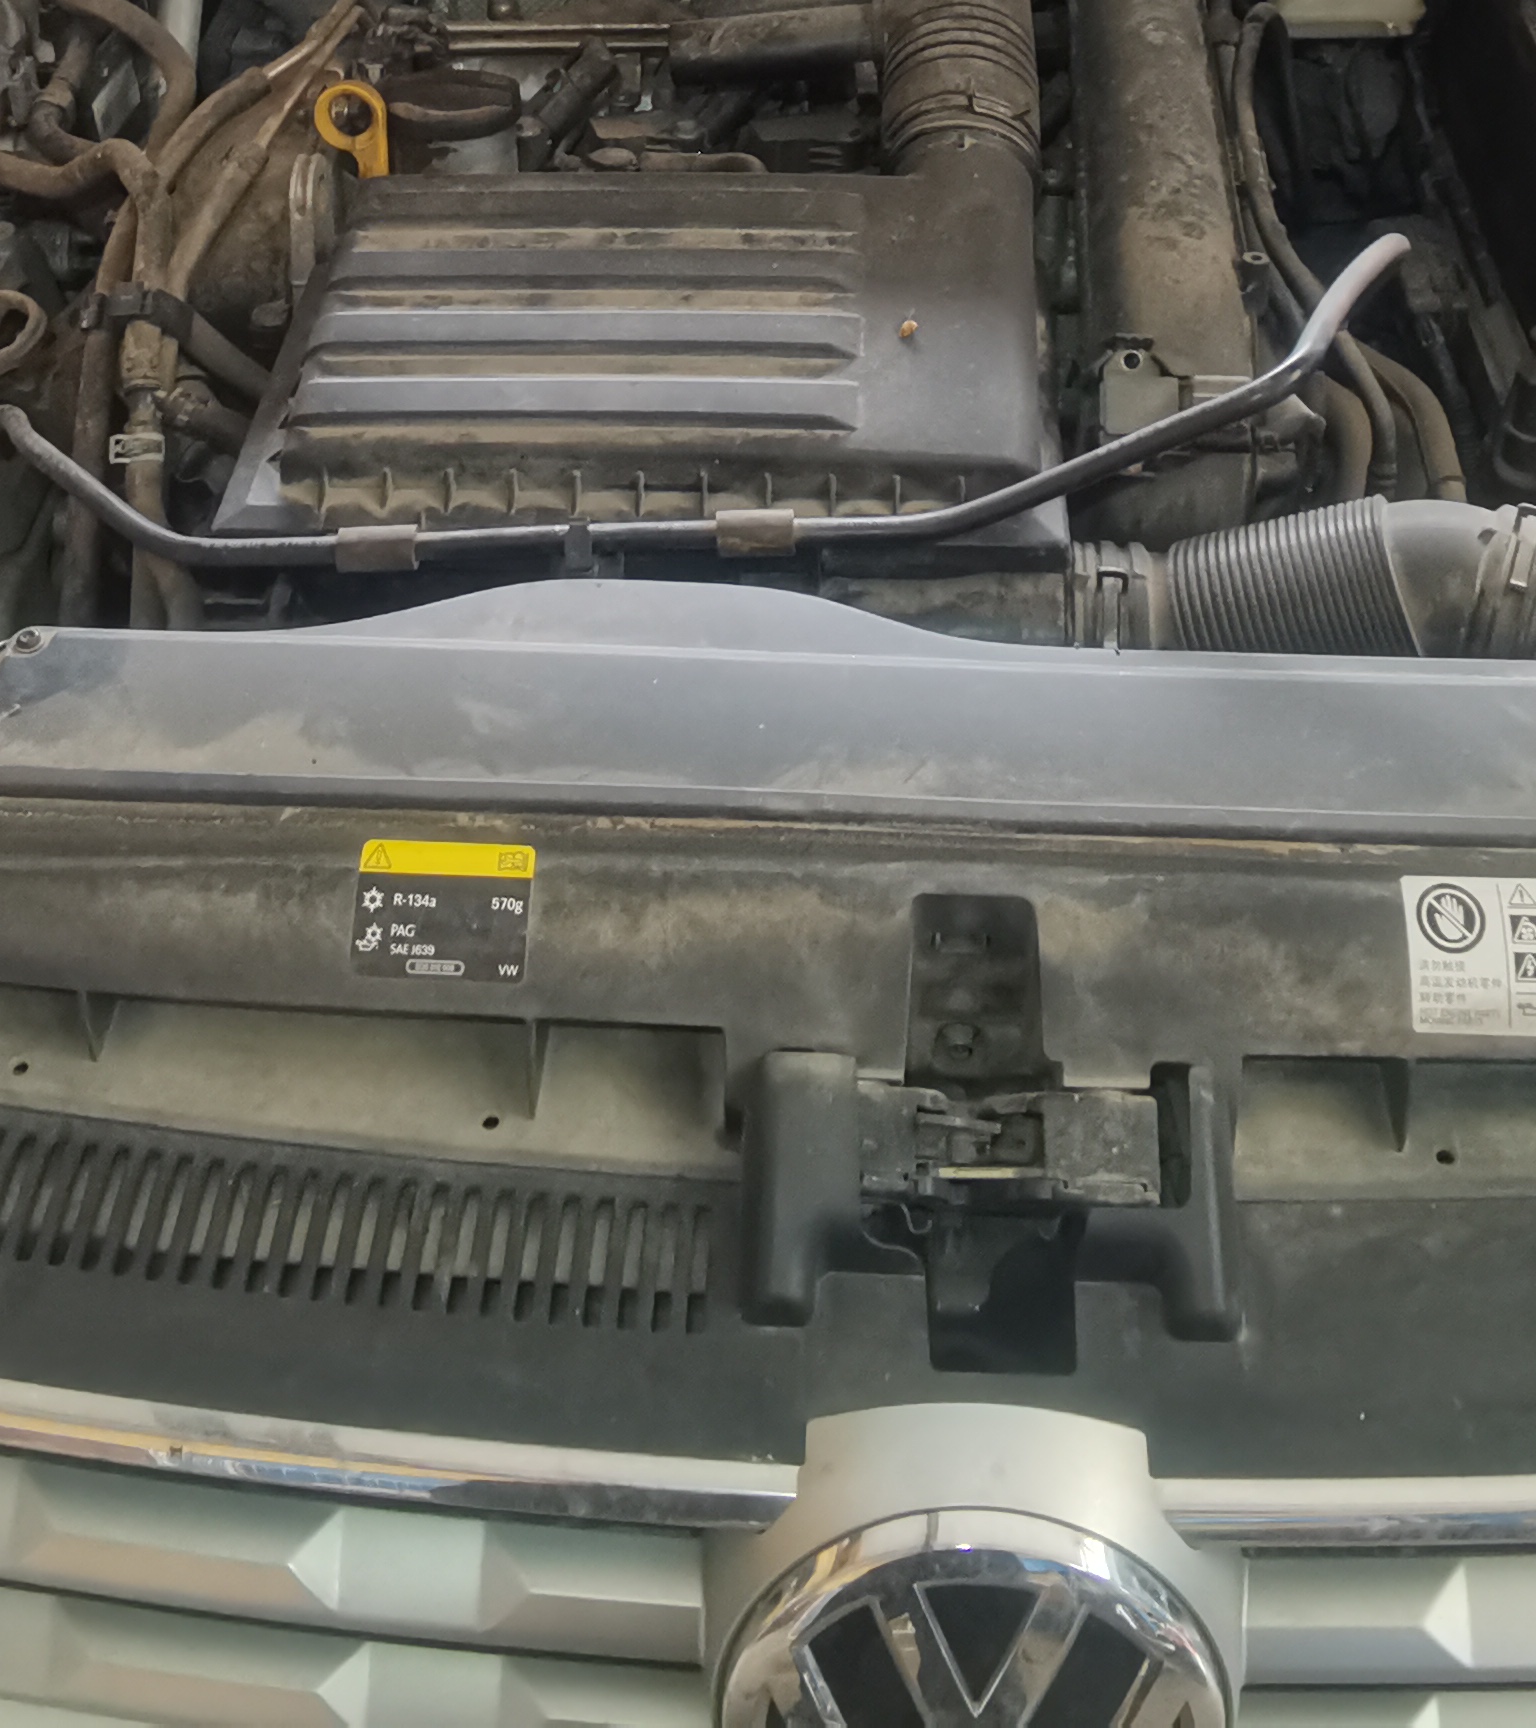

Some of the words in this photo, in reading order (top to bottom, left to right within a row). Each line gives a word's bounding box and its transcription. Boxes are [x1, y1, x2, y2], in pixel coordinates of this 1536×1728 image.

[392, 892, 437, 908] R-134a
[491, 896, 524, 915] 570g
[390, 923, 417, 938] PAG
[389, 943, 410, 955] SAE
[497, 963, 520, 976] VW
